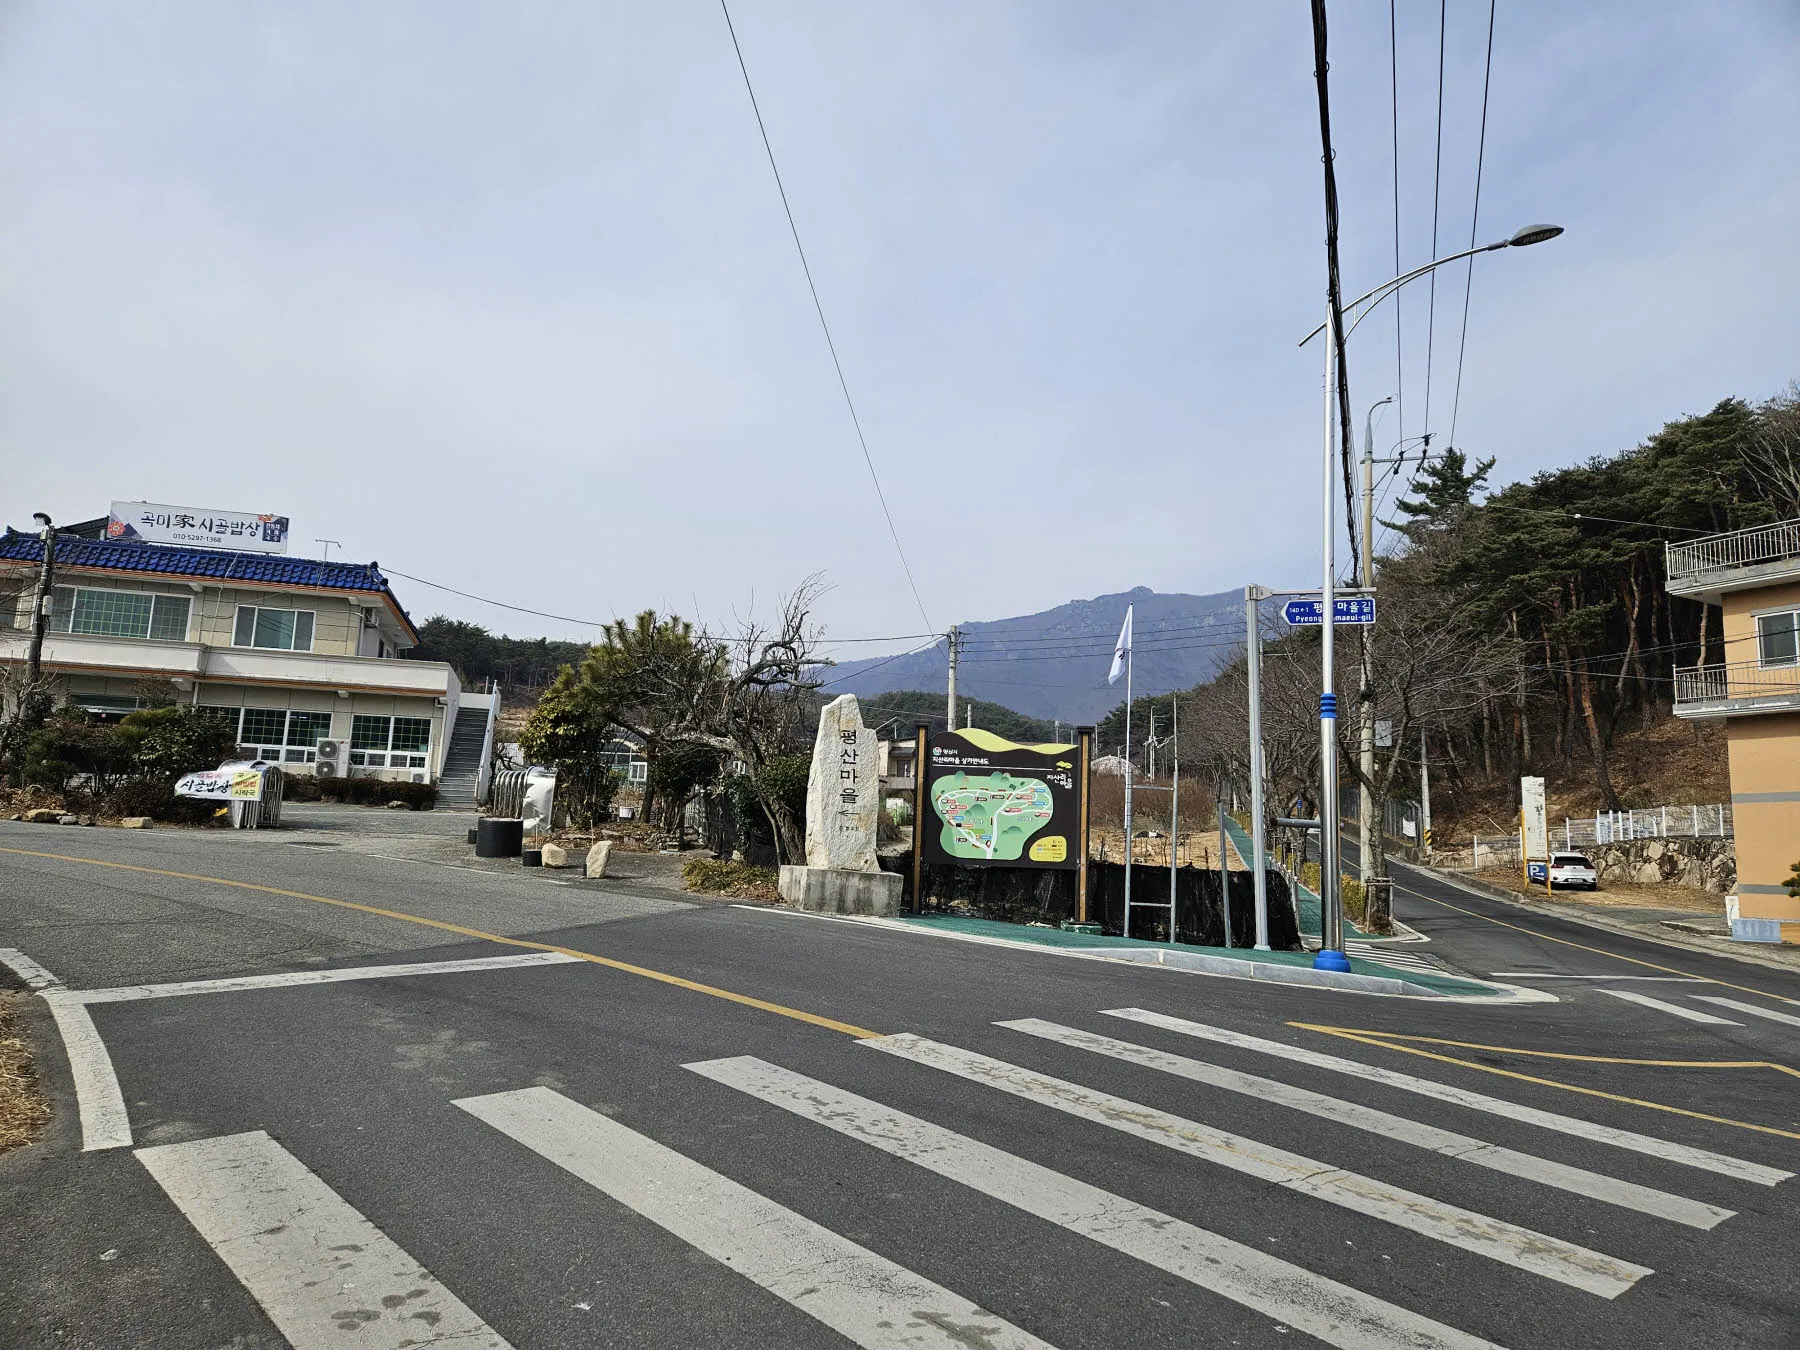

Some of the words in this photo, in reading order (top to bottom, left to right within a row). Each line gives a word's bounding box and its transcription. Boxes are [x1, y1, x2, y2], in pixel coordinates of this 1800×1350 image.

[198, 516, 261, 537] 시골밥상
[173, 533, 222, 543] 010-5297-1368
[1313, 602, 1371, 613] 평마을길
[1295, 614, 1371, 622] Pyeongmaeul-gil
[932, 756, 960, 764] 지산리마을
[840, 729, 859, 804] 평산마을
[1046, 773, 1067, 784] 지산리
[180, 779, 232, 794] 시골밥상
[1529, 865, 1540, 876] P
